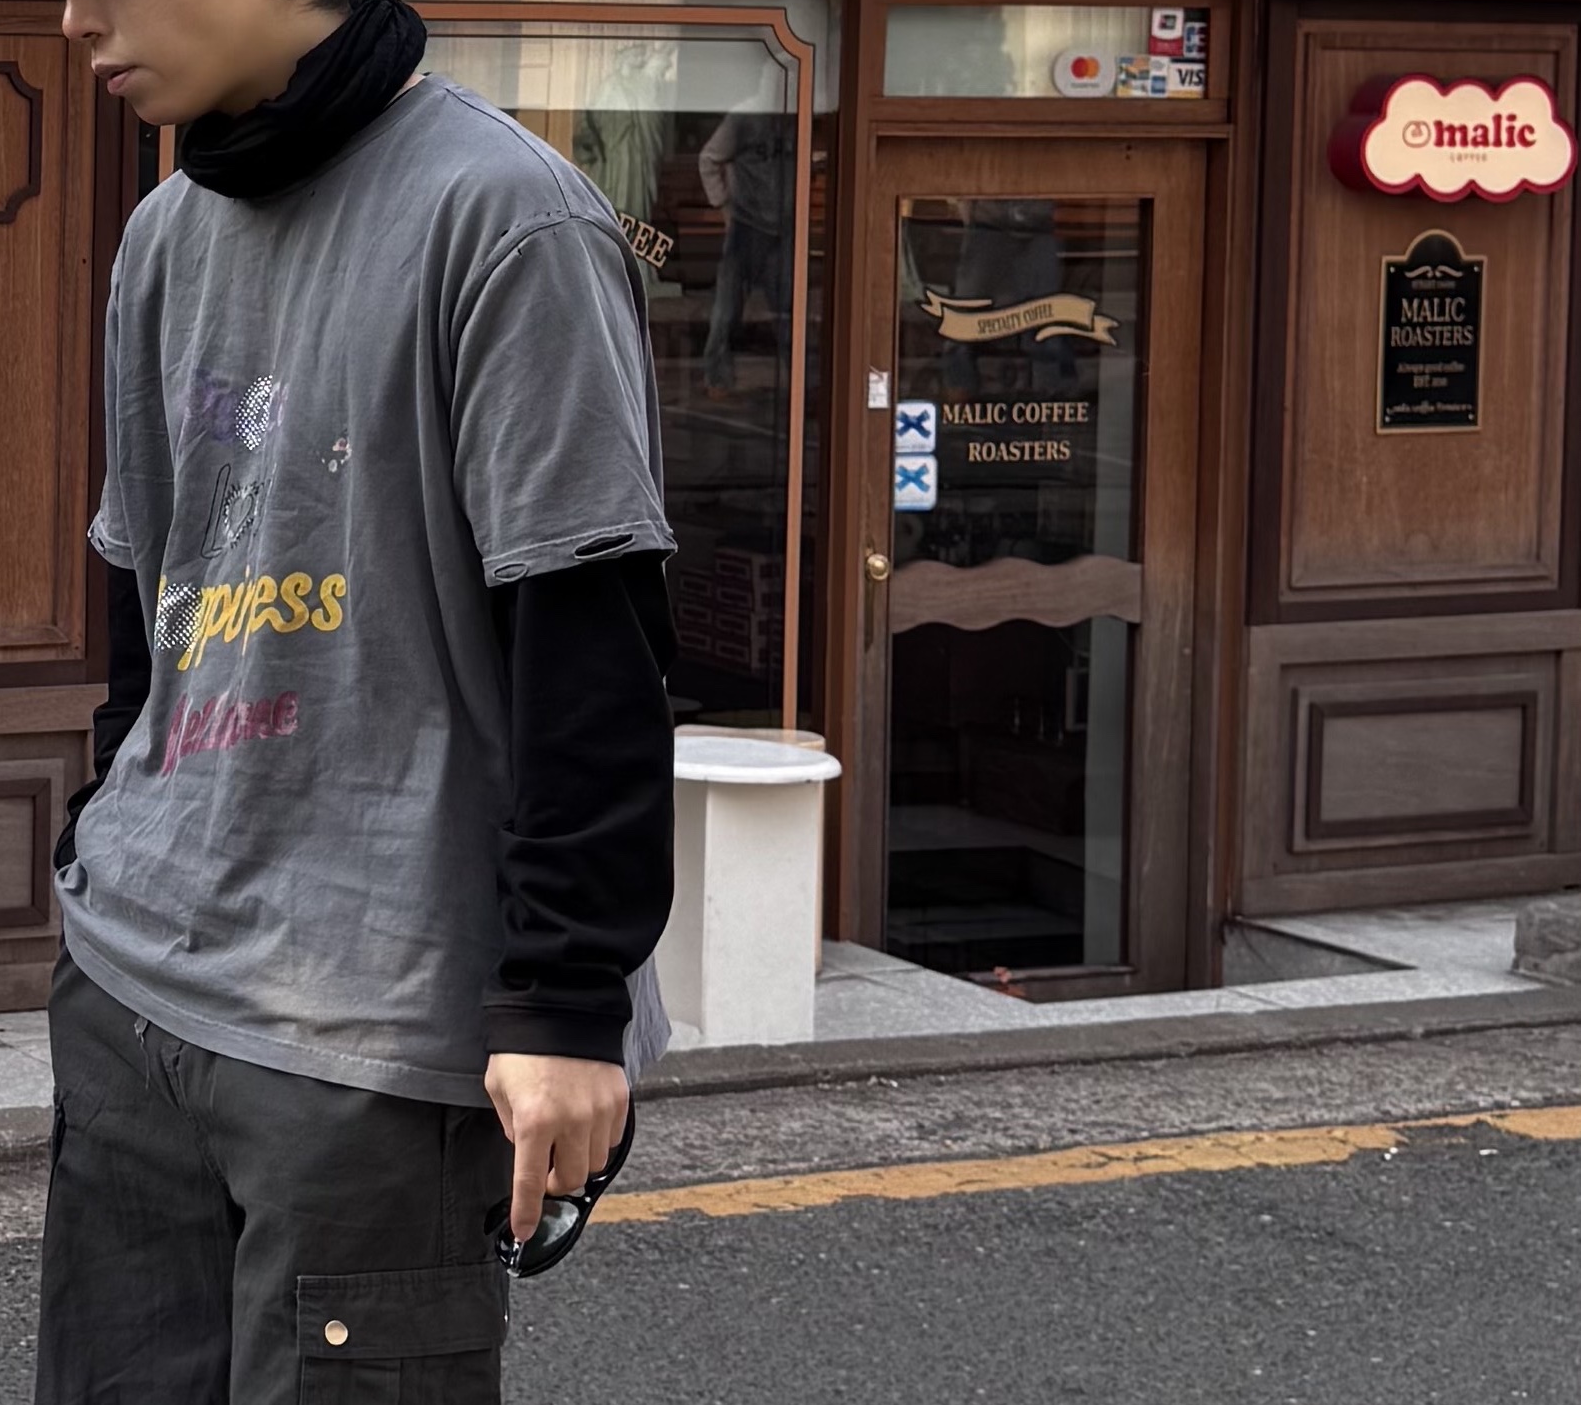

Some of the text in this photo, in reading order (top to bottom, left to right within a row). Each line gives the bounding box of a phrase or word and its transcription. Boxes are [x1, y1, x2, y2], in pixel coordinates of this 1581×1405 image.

[1176, 68, 1206, 87] VIS
[1433, 113, 1537, 149] malic
[1023, 303, 1054, 325] COFFEE
[1401, 297, 1466, 323] MALIC
[1390, 326, 1475, 348] ROASTERS
[942, 401, 1089, 424] MALIC COFFEE
[968, 441, 1071, 462] ROASTERS
